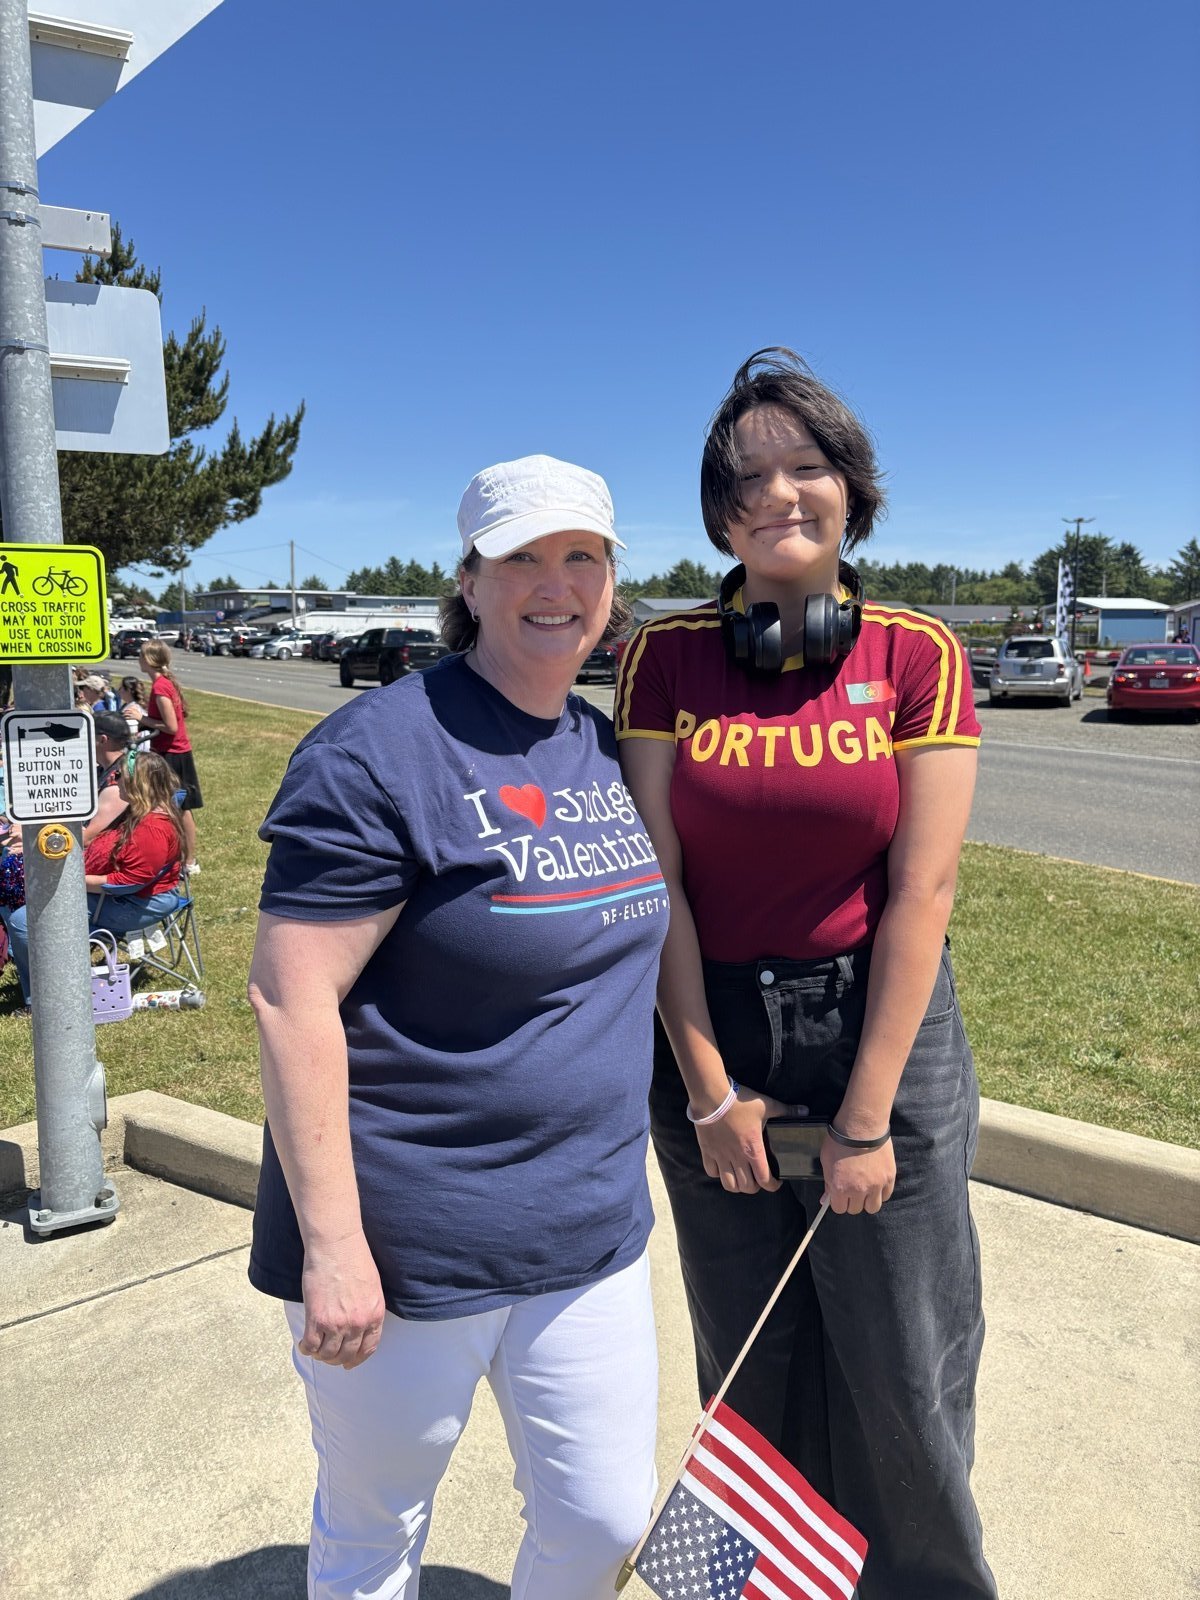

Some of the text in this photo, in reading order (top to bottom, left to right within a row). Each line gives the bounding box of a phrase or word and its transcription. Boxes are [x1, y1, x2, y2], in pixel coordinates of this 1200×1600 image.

[1, 602, 86, 613] CROSS TRAFFIC
[3, 615, 86, 626] MAY NOT STOP
[9, 628, 82, 639] USE CAUTION
[0, 642, 92, 653] WHEN CROSSING
[35, 746, 66, 758] PUSH
[18, 759, 83, 772] BUTTON TO
[25, 773, 79, 786] TURN ON
[27, 787, 78, 800] WARNING
[34, 801, 73, 813] LIGHTS
[463, 788, 502, 839] I
[601, 897, 660, 927] RE-ELECT
